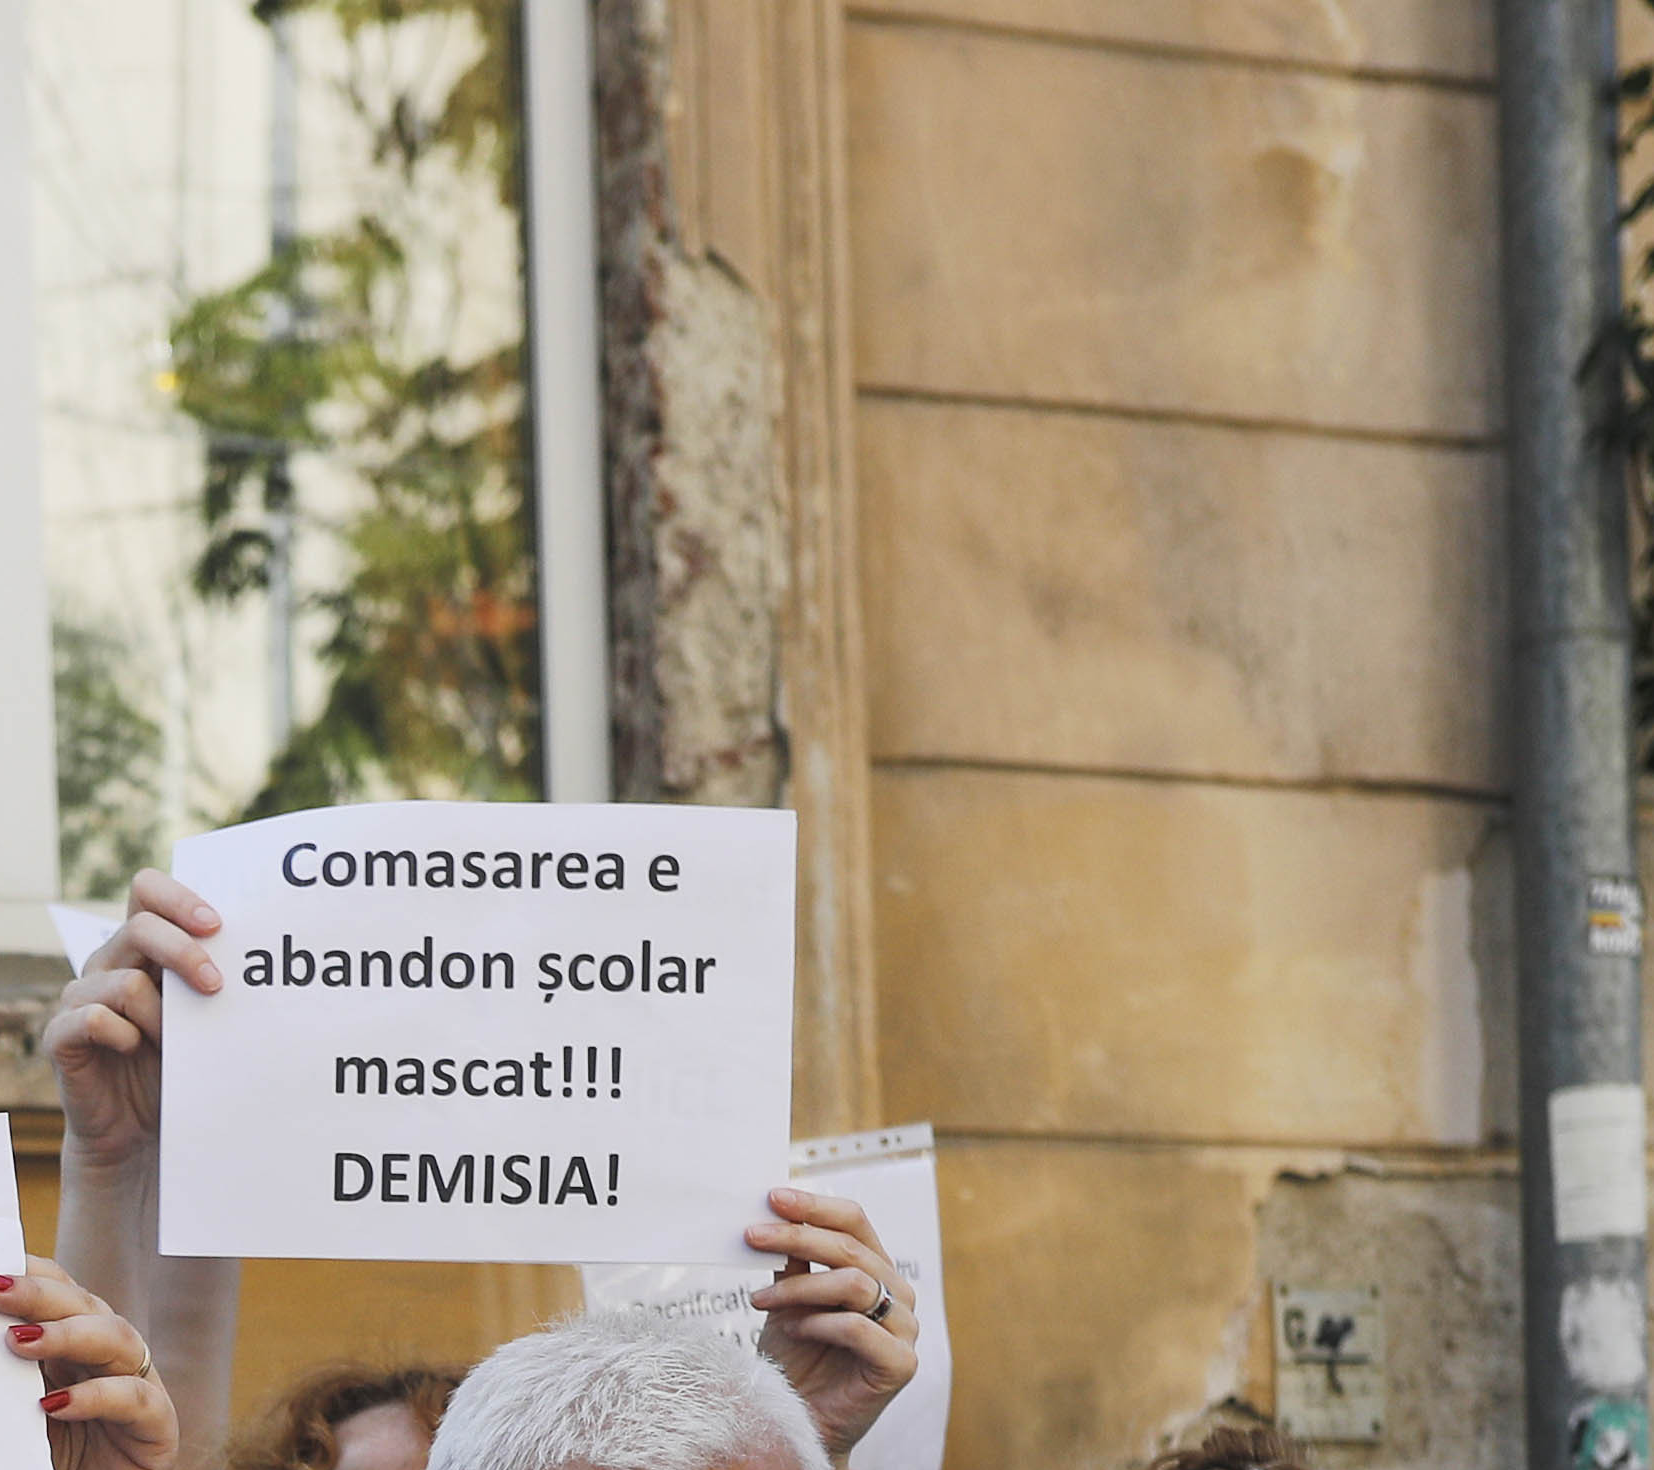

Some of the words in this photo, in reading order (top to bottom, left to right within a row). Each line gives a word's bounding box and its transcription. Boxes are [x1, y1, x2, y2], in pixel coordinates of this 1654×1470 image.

[282, 842, 625, 891] Comasarea
[648, 854, 680, 893] e
[242, 934, 514, 990] abandon
[538, 939, 716, 1004] școlar
[335, 1045, 622, 1099] mascat!!!
[333, 1152, 620, 1207] DEMISIA!
